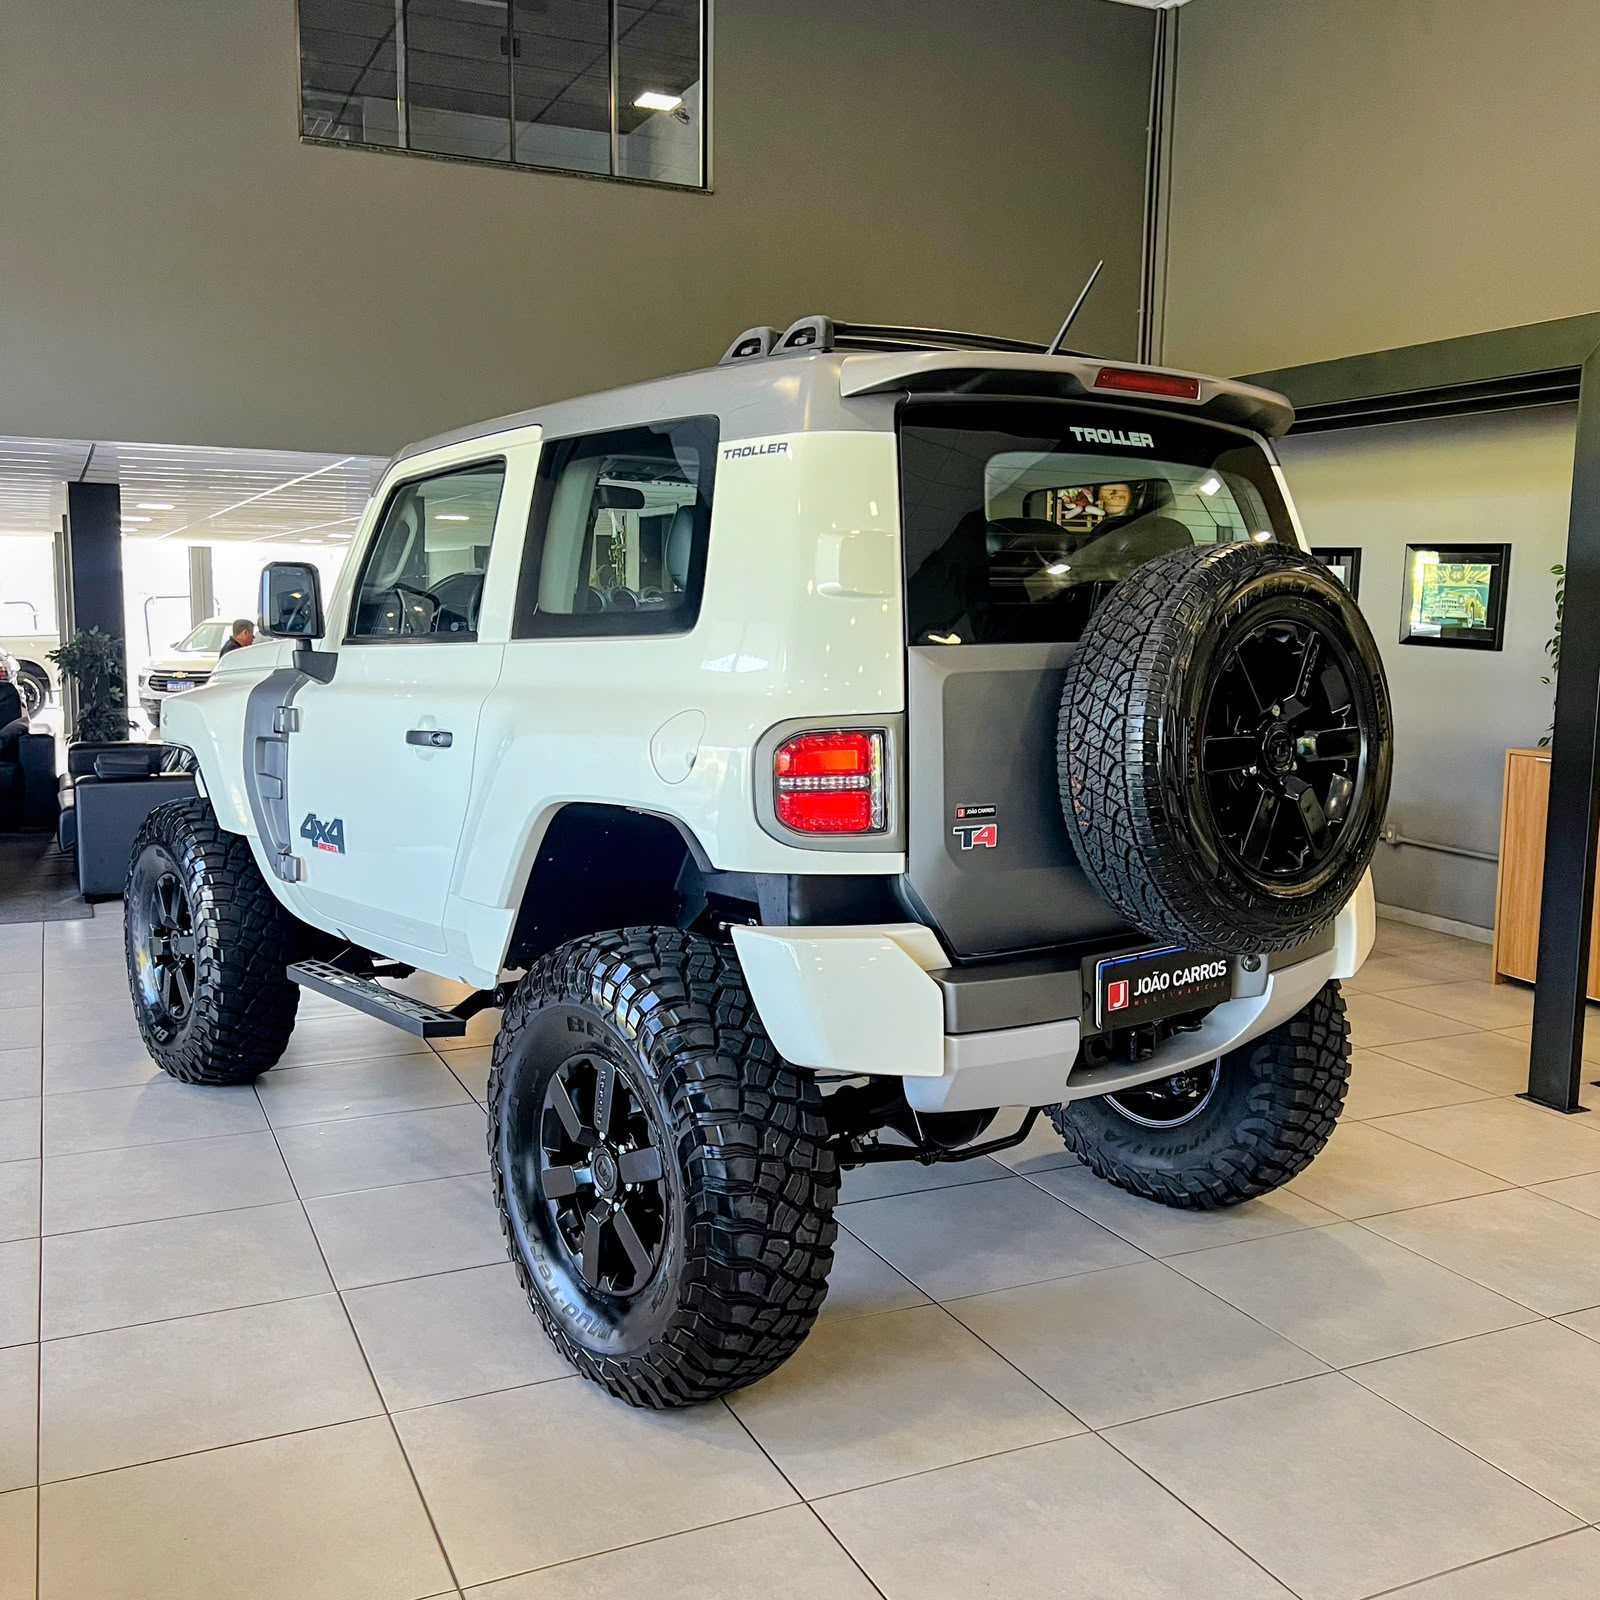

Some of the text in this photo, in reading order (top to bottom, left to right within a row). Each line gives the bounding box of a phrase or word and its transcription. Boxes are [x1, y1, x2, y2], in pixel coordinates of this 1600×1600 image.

[1069, 426, 1154, 448] TROLLER
[723, 442, 788, 460] TROLLER
[953, 823, 997, 849] T4
[1134, 960, 1227, 996] JOÃO CARROS
